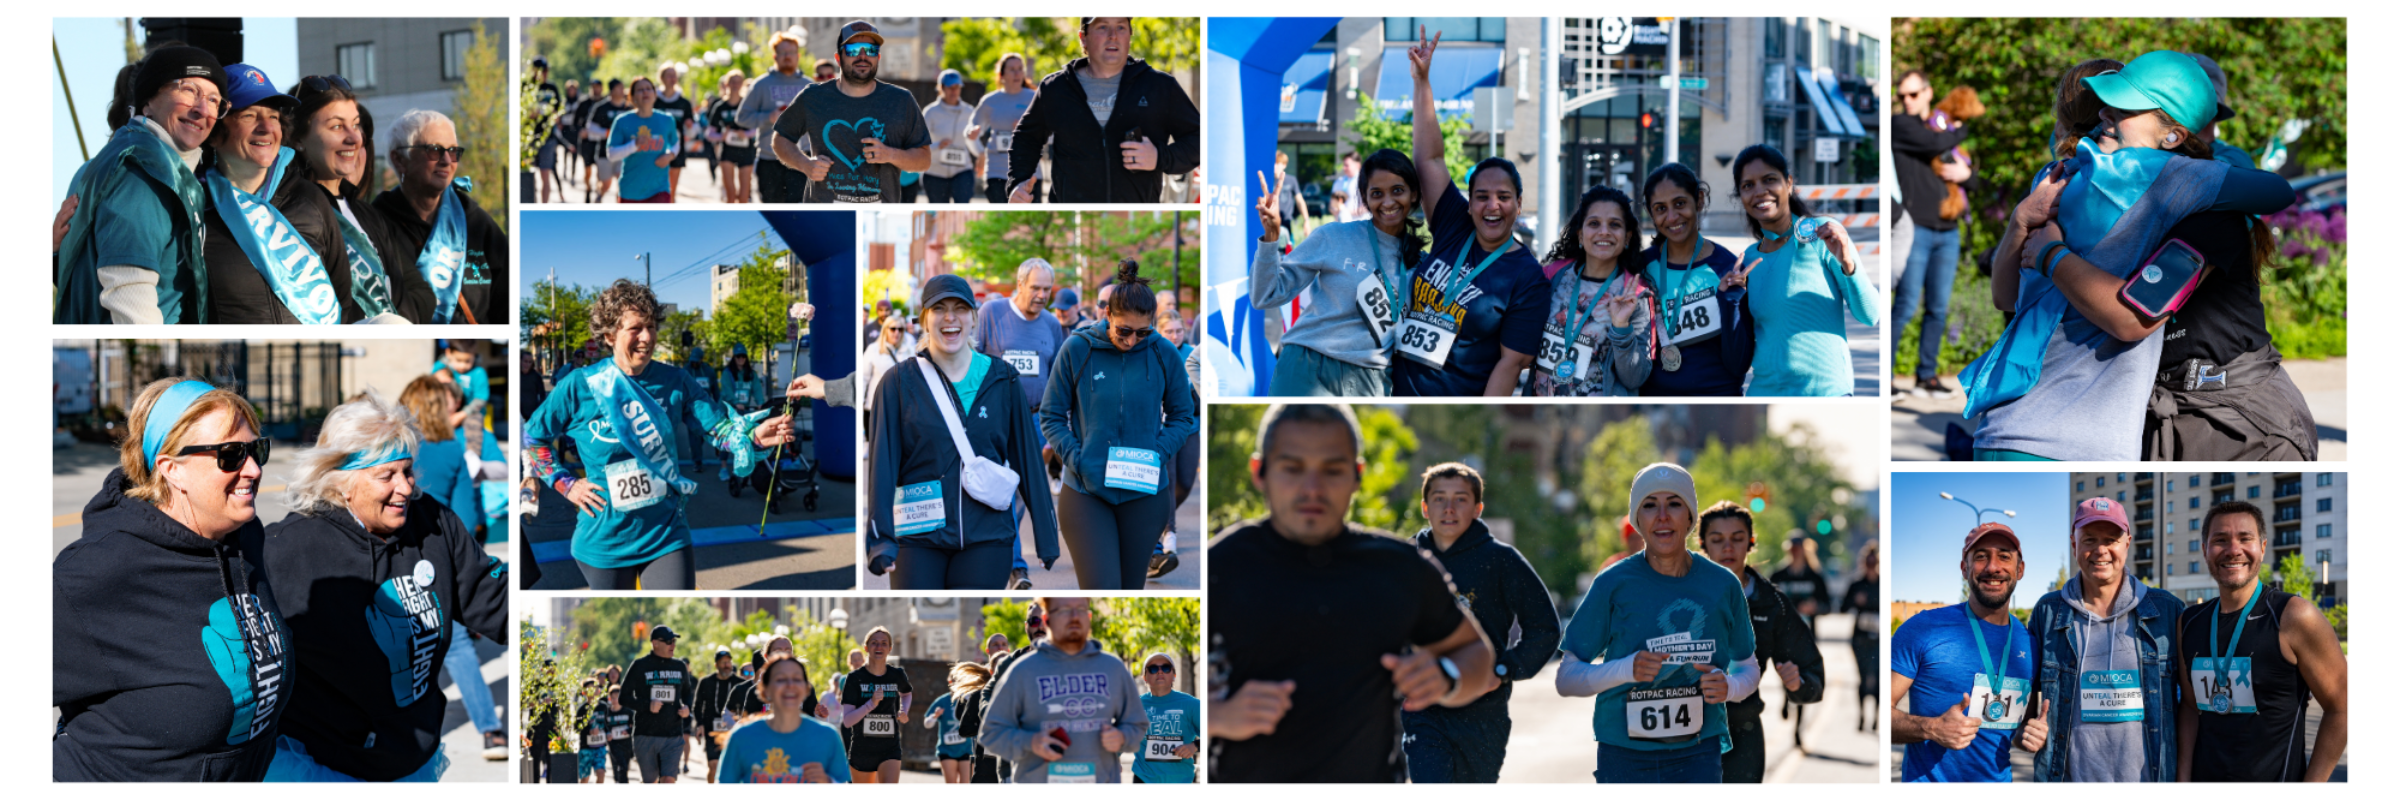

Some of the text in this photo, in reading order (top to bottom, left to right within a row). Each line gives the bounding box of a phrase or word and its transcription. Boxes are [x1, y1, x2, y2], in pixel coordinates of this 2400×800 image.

[1684, 289, 1711, 303] RACING
[1364, 287, 1394, 333] 852
[1427, 314, 1454, 330] RACING
[1402, 324, 1440, 352] 853
[1010, 358, 1033, 370] 753
[1126, 450, 1154, 460] MIOCA
[617, 473, 651, 500] 285
[906, 485, 933, 496] MIOCA
[402, 591, 433, 616] FIGHT
[408, 616, 421, 636] IS
[420, 607, 440, 631] MY
[1654, 642, 1713, 653] MOTHER'S DAY
[1676, 655, 1691, 663] FUN
[412, 632, 439, 701] FIGHT
[2101, 673, 2133, 682] MIOCA
[655, 690, 671, 699] 801
[1037, 673, 1110, 702] ELDER
[1631, 687, 1697, 700] ROTPAC RACING
[249, 660, 283, 741] FIGHT
[2113, 691, 2142, 699] THERE'S
[1981, 693, 2011, 717] 11
[1641, 704, 1691, 731] 614
[869, 721, 890, 731] 800
[1146, 720, 1182, 735] EAL
[1152, 743, 1176, 755] 904
